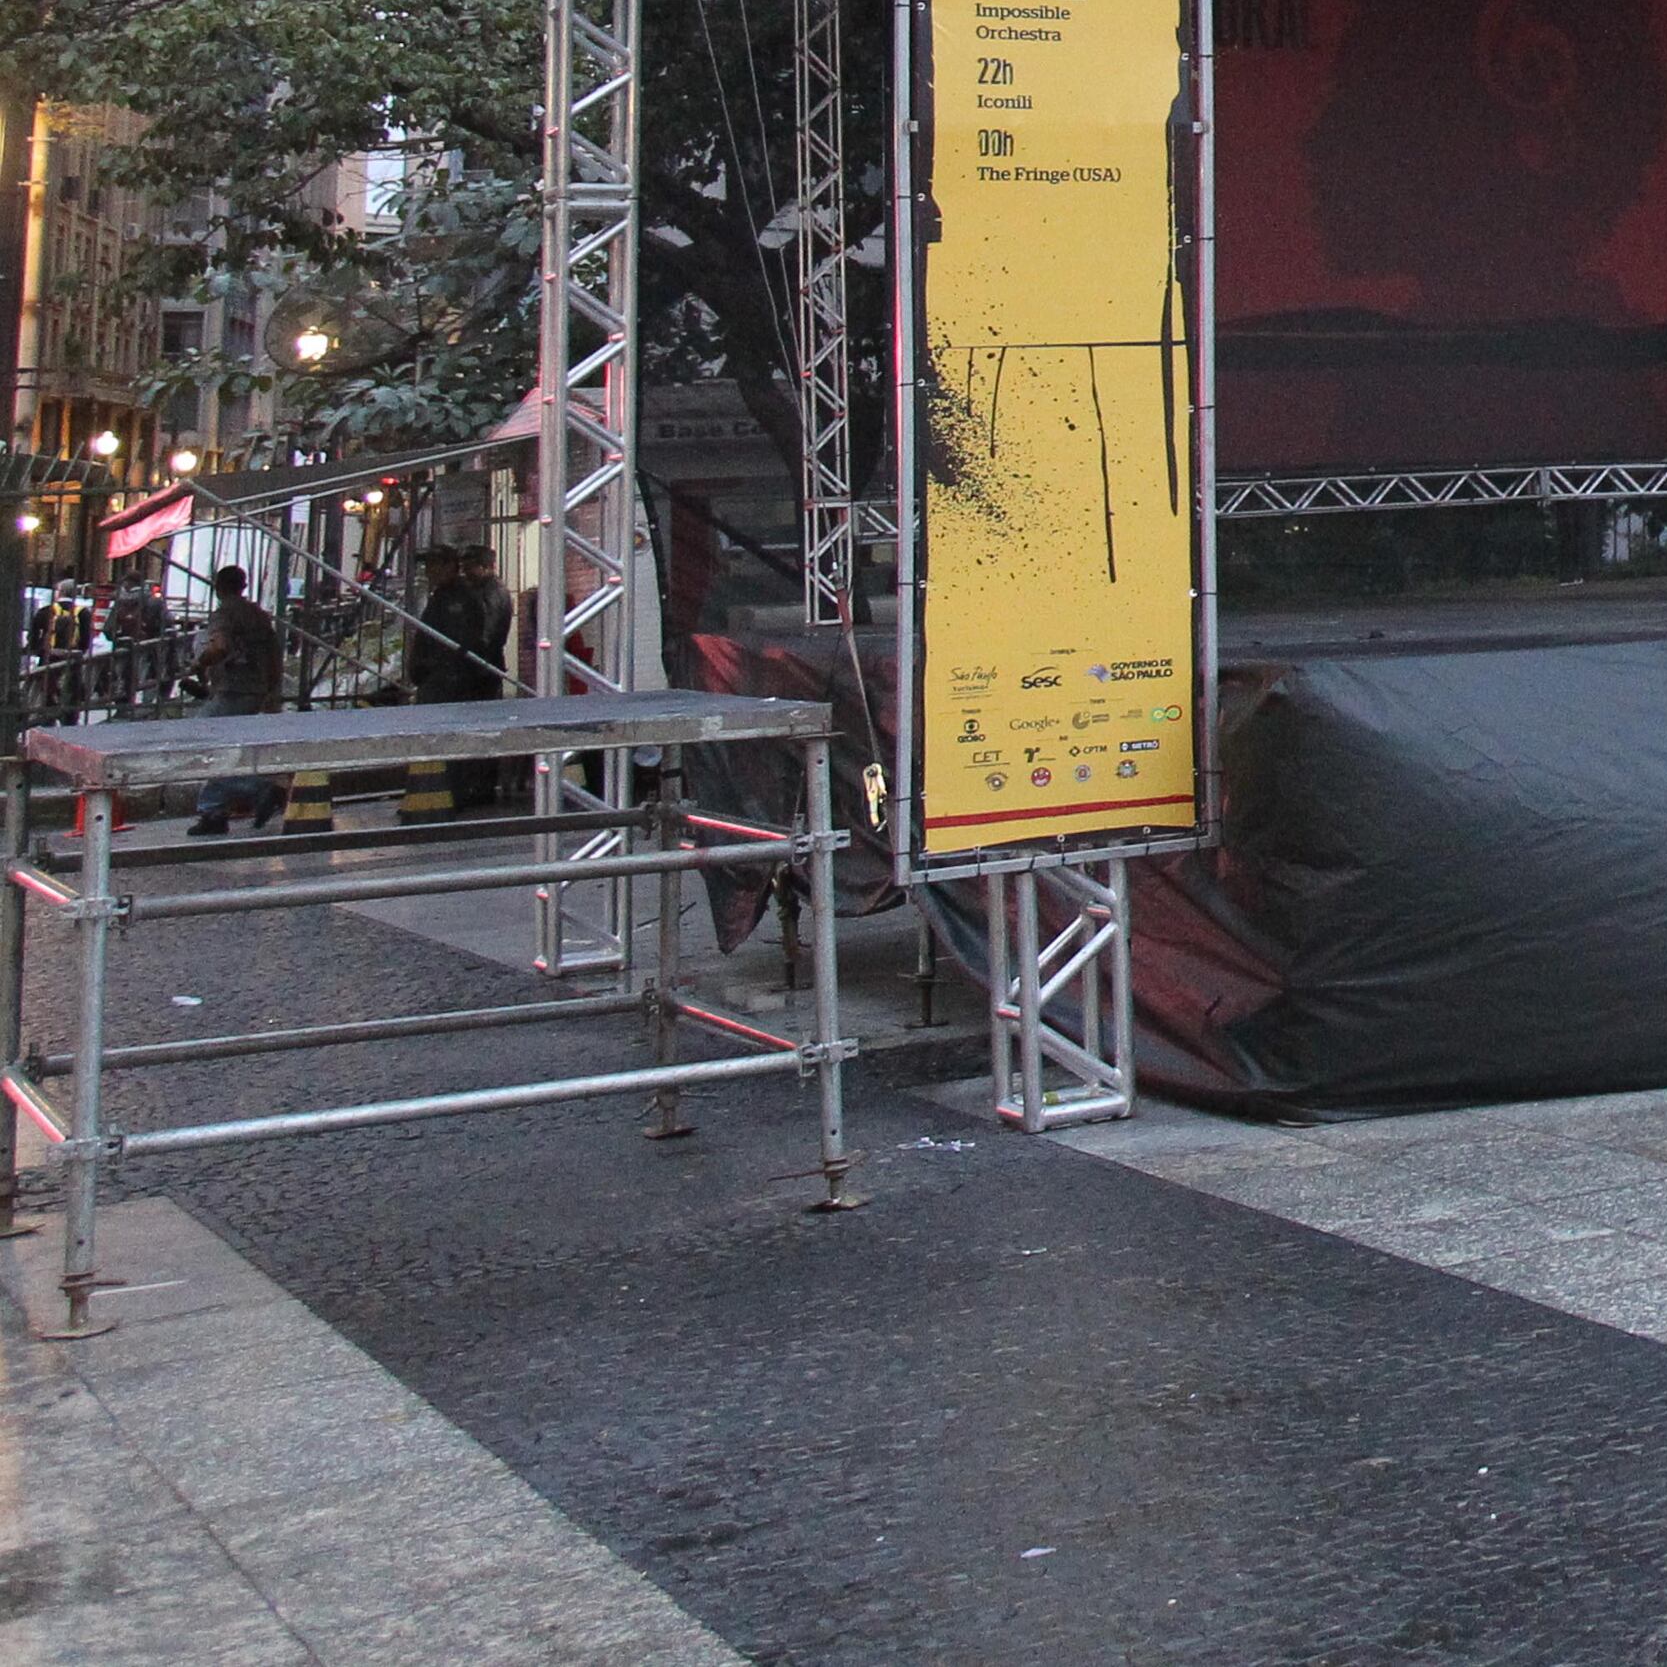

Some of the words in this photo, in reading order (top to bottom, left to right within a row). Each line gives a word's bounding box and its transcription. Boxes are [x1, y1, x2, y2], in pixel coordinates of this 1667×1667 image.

[975, 3, 1071, 21] Impossible
[976, 26, 1062, 42] Orchestra
[977, 58, 1013, 85] 22h
[977, 94, 1033, 110] Iconili
[977, 129, 1014, 157] 00h
[977, 167, 1011, 181] The
[1014, 167, 1070, 184] Fringe
[1073, 167, 1121, 184] (USA)
[1111, 660, 1159, 670] GOVERNO
[1160, 658, 1173, 667] DE
[1137, 668, 1173, 679] PAULO
[973, 749, 1002, 763] CET
[1083, 745, 1107, 754] CPTM
